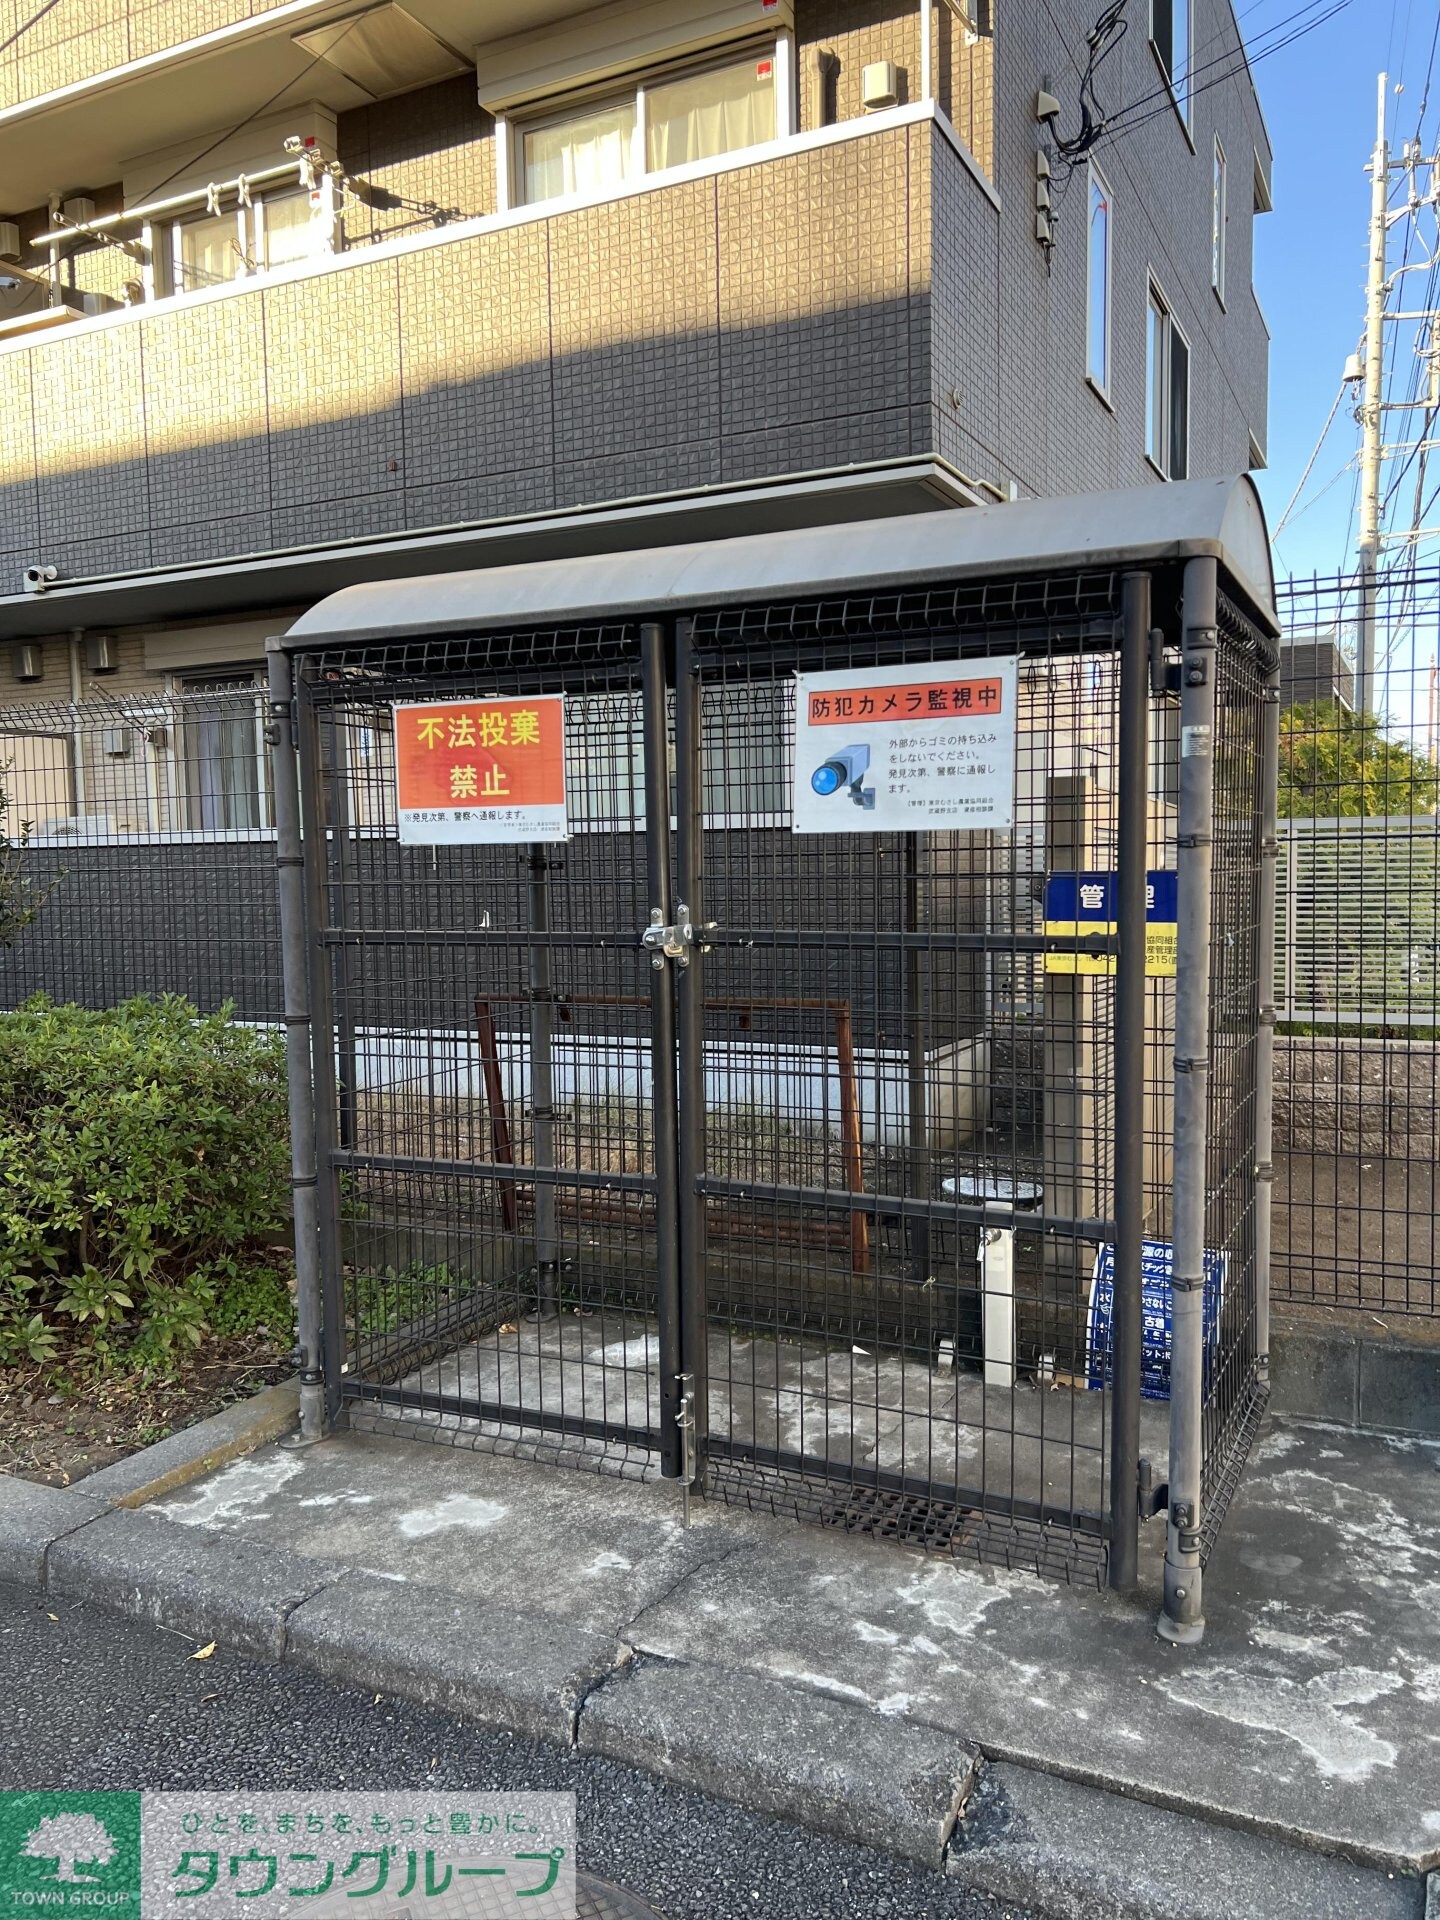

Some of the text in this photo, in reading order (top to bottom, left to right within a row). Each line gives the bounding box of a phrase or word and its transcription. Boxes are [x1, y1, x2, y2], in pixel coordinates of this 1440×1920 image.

[812, 685, 997, 718] 防犯カメラ監視中
[417, 709, 540, 749] 不法投棄
[889, 733, 997, 749] 外部からゴミの持ち込み
[889, 751, 980, 764] をしないでください。
[888, 764, 996, 779] 発見次第、警察に通報し
[450, 764, 510, 799] 禁止
[888, 784, 911, 794] ます。
